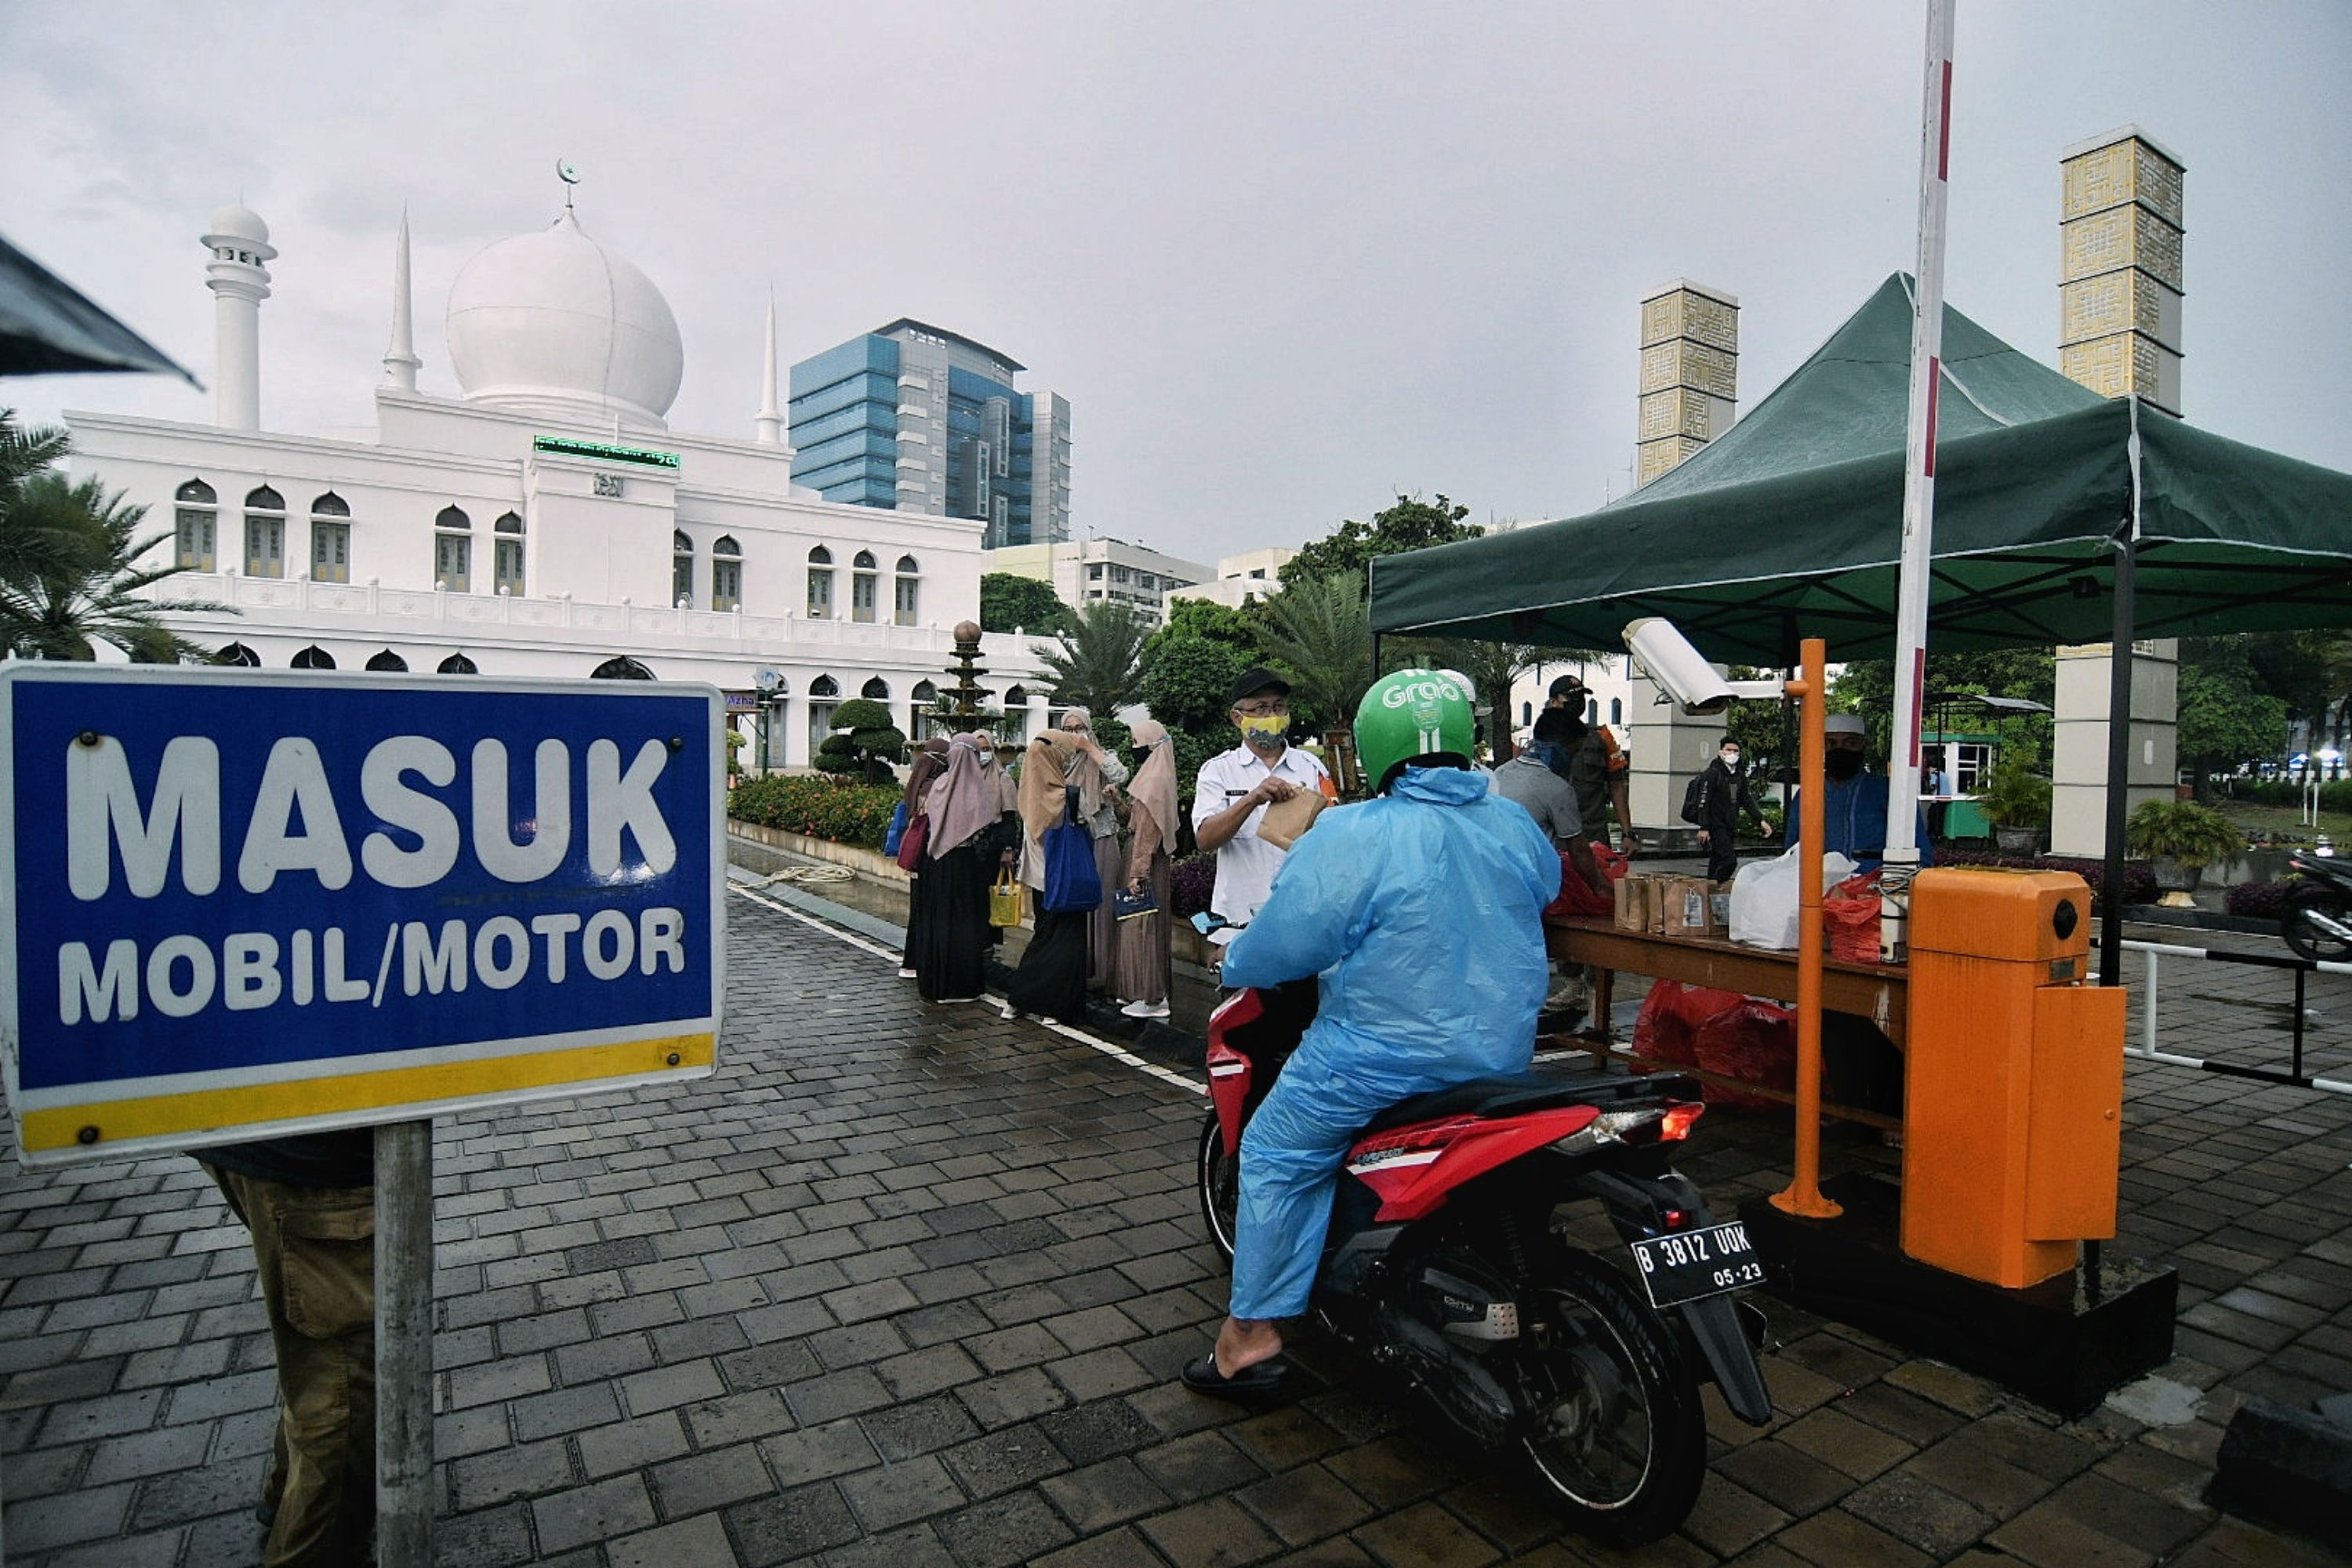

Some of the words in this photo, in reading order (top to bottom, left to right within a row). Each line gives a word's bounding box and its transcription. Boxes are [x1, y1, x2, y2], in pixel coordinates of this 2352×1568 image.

[1383, 678, 1459, 708] Grab
[66, 735, 678, 901] MASUK
[58, 907, 685, 1025] MOBIL/MOTOR
[1637, 1247, 1654, 1272] B
[1660, 1235, 1710, 1267] 3812
[1714, 1225, 1751, 1255] UQK
